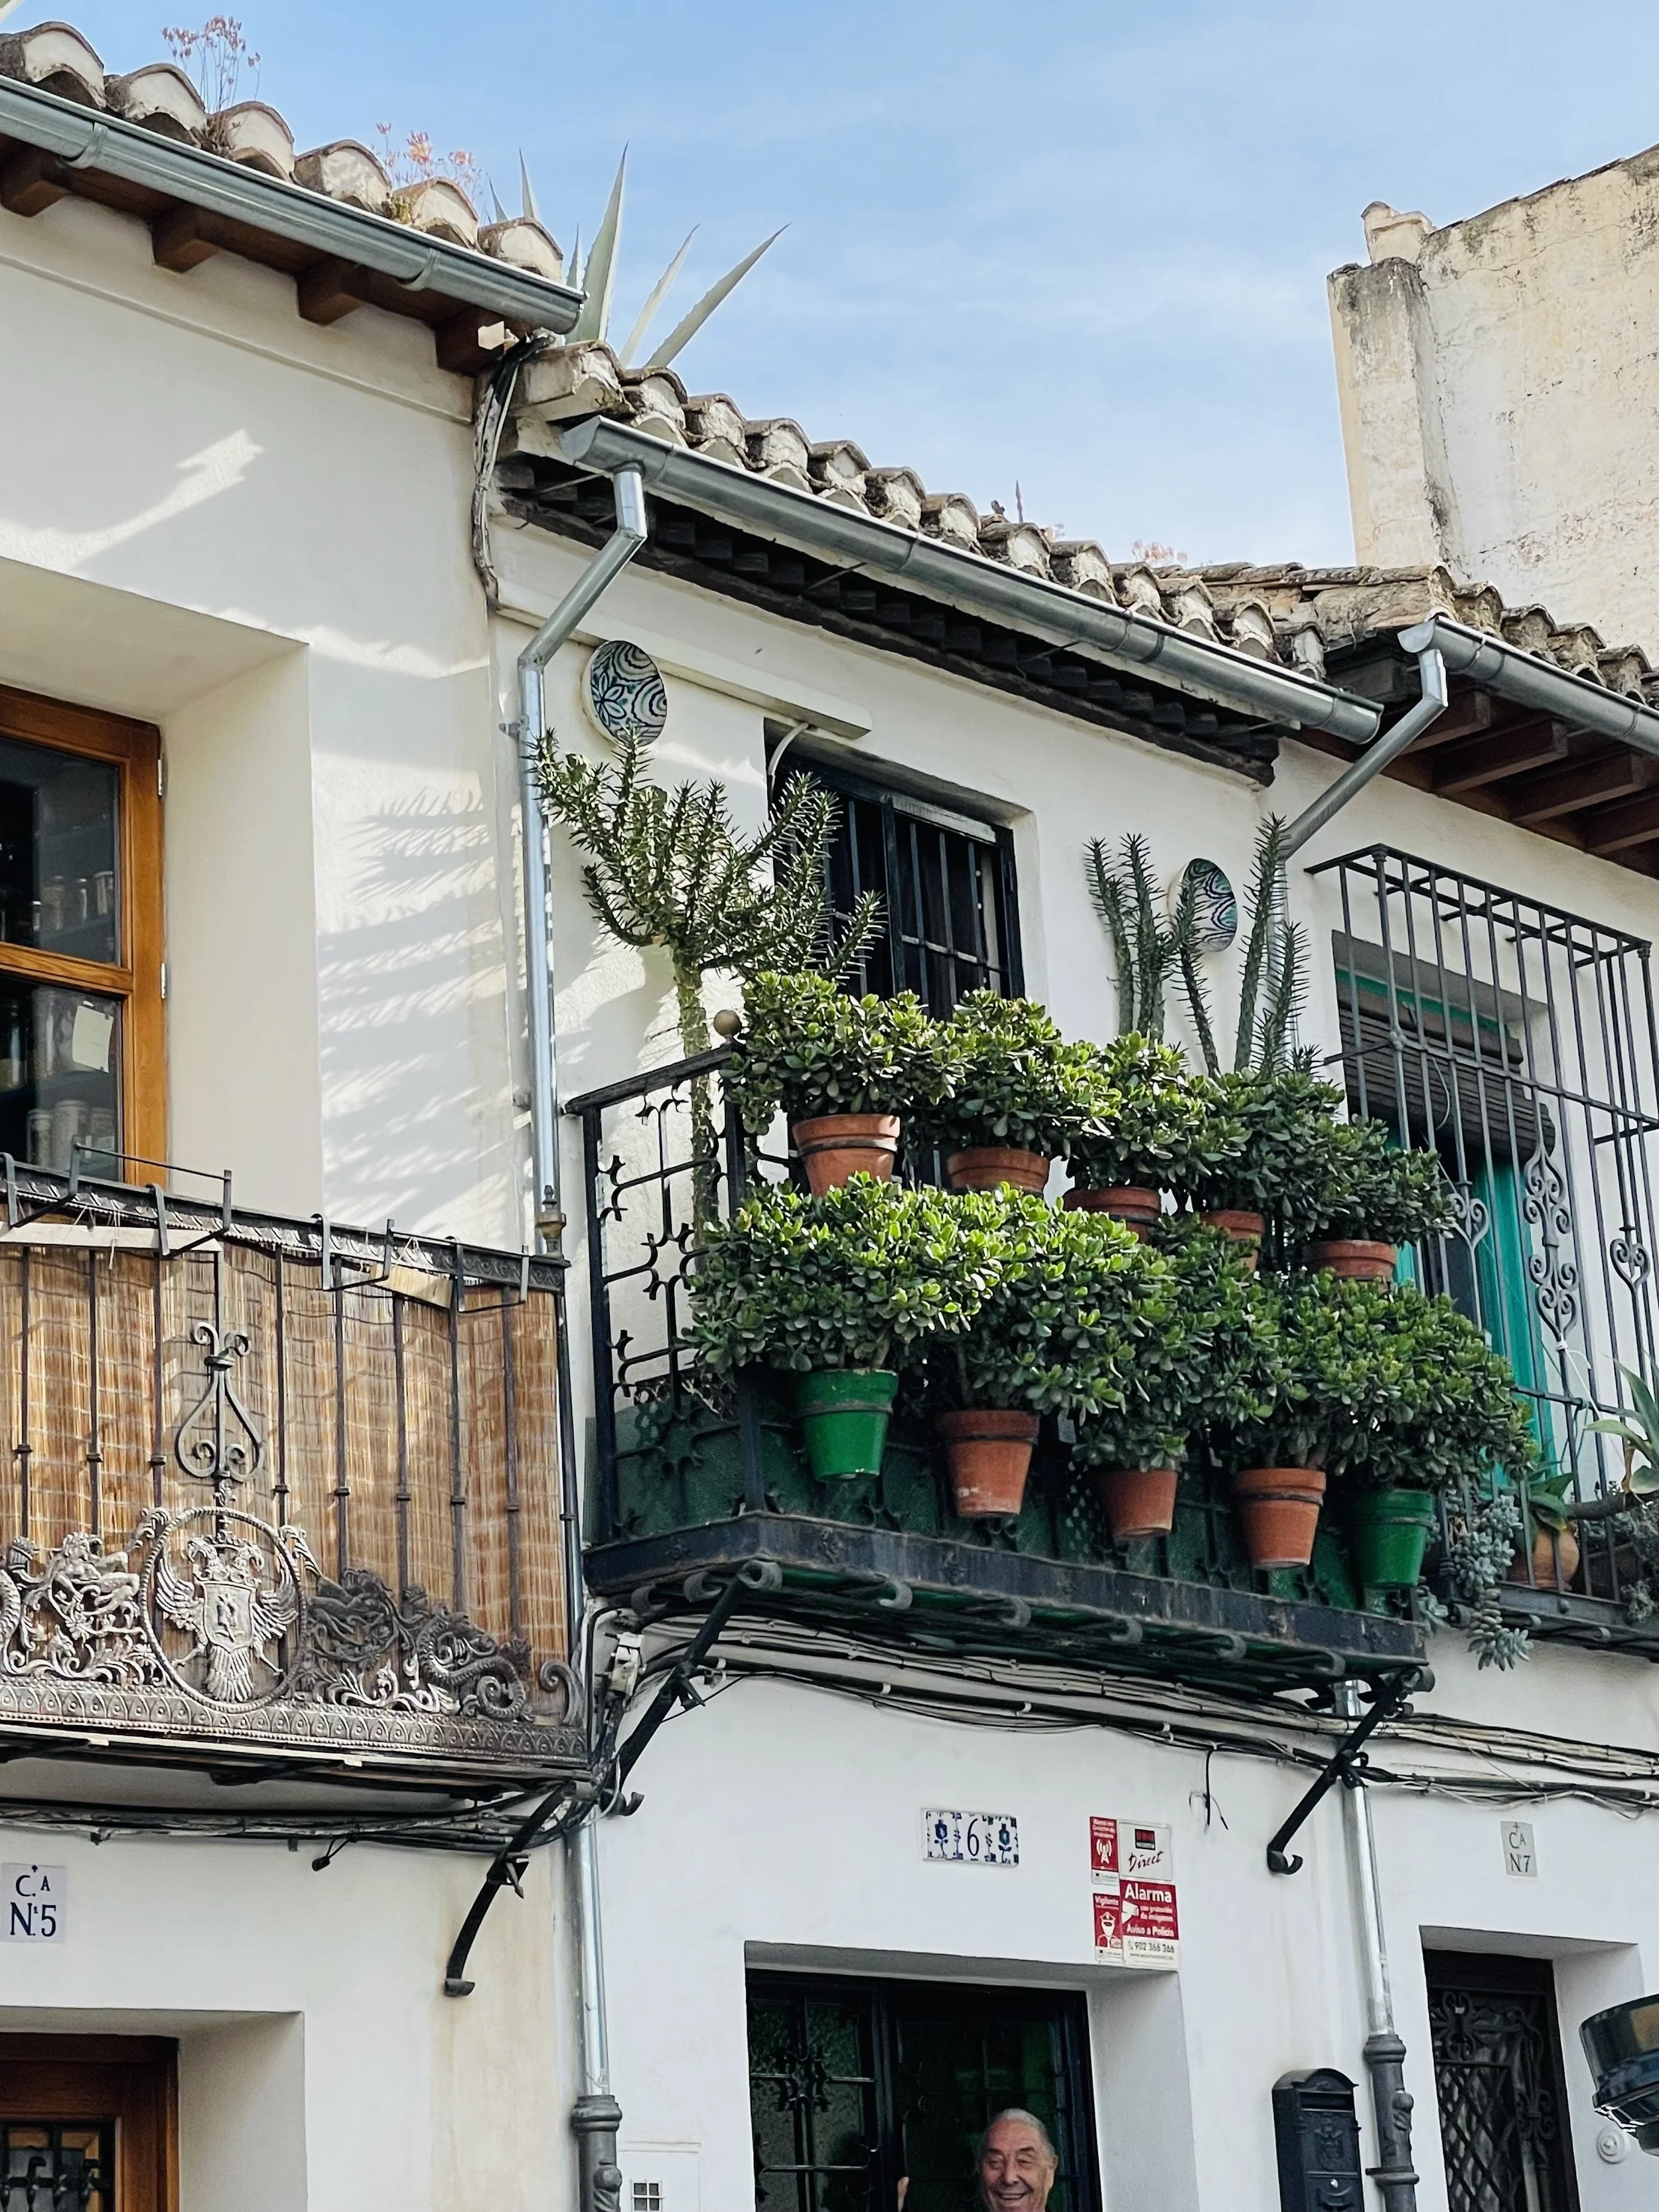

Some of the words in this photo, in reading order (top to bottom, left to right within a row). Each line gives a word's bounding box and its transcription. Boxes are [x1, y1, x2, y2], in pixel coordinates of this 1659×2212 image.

[967, 1818, 979, 1857] 6
[1127, 1850, 1165, 1873] Direct
[1125, 1883, 1173, 1903] Alarma
[1127, 1923, 1145, 1935] Aviso
[1152, 1925, 1175, 1937] Policía
[1135, 1942, 1147, 1951] 902
[1149, 1943, 1161, 1953] 366
